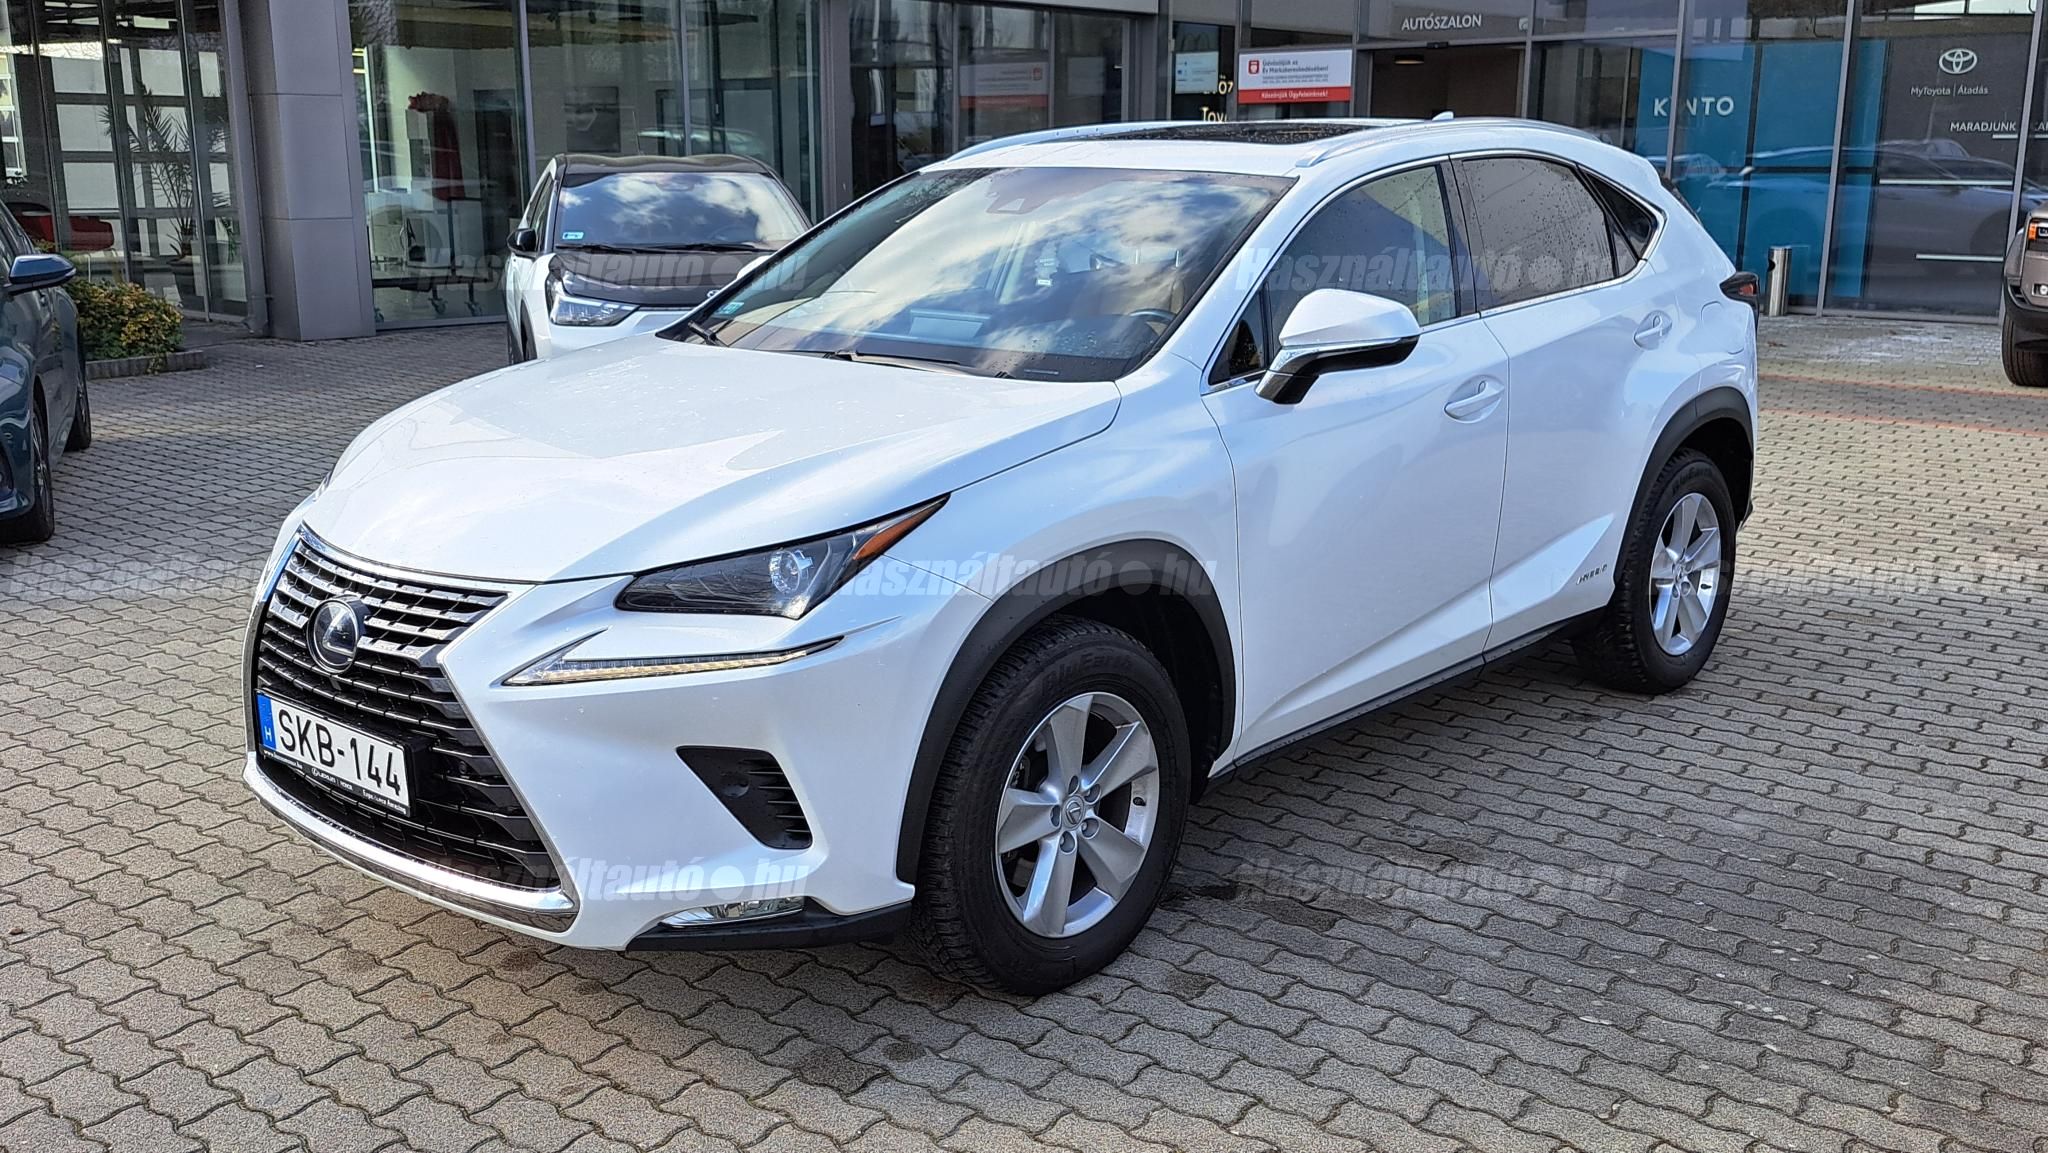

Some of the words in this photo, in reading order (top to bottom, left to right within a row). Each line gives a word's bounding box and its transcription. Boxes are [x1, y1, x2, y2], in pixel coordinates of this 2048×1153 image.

[1401, 12, 1482, 31] AUTÓSZALON
[1910, 85, 1951, 97] MyToyota
[1957, 83, 1989, 95] Átadás
[1653, 96, 1735, 117] KNTO
[1949, 121, 2017, 132] MARADJUNK
[264, 725, 272, 742] H
[278, 709, 402, 797] SKB-144
